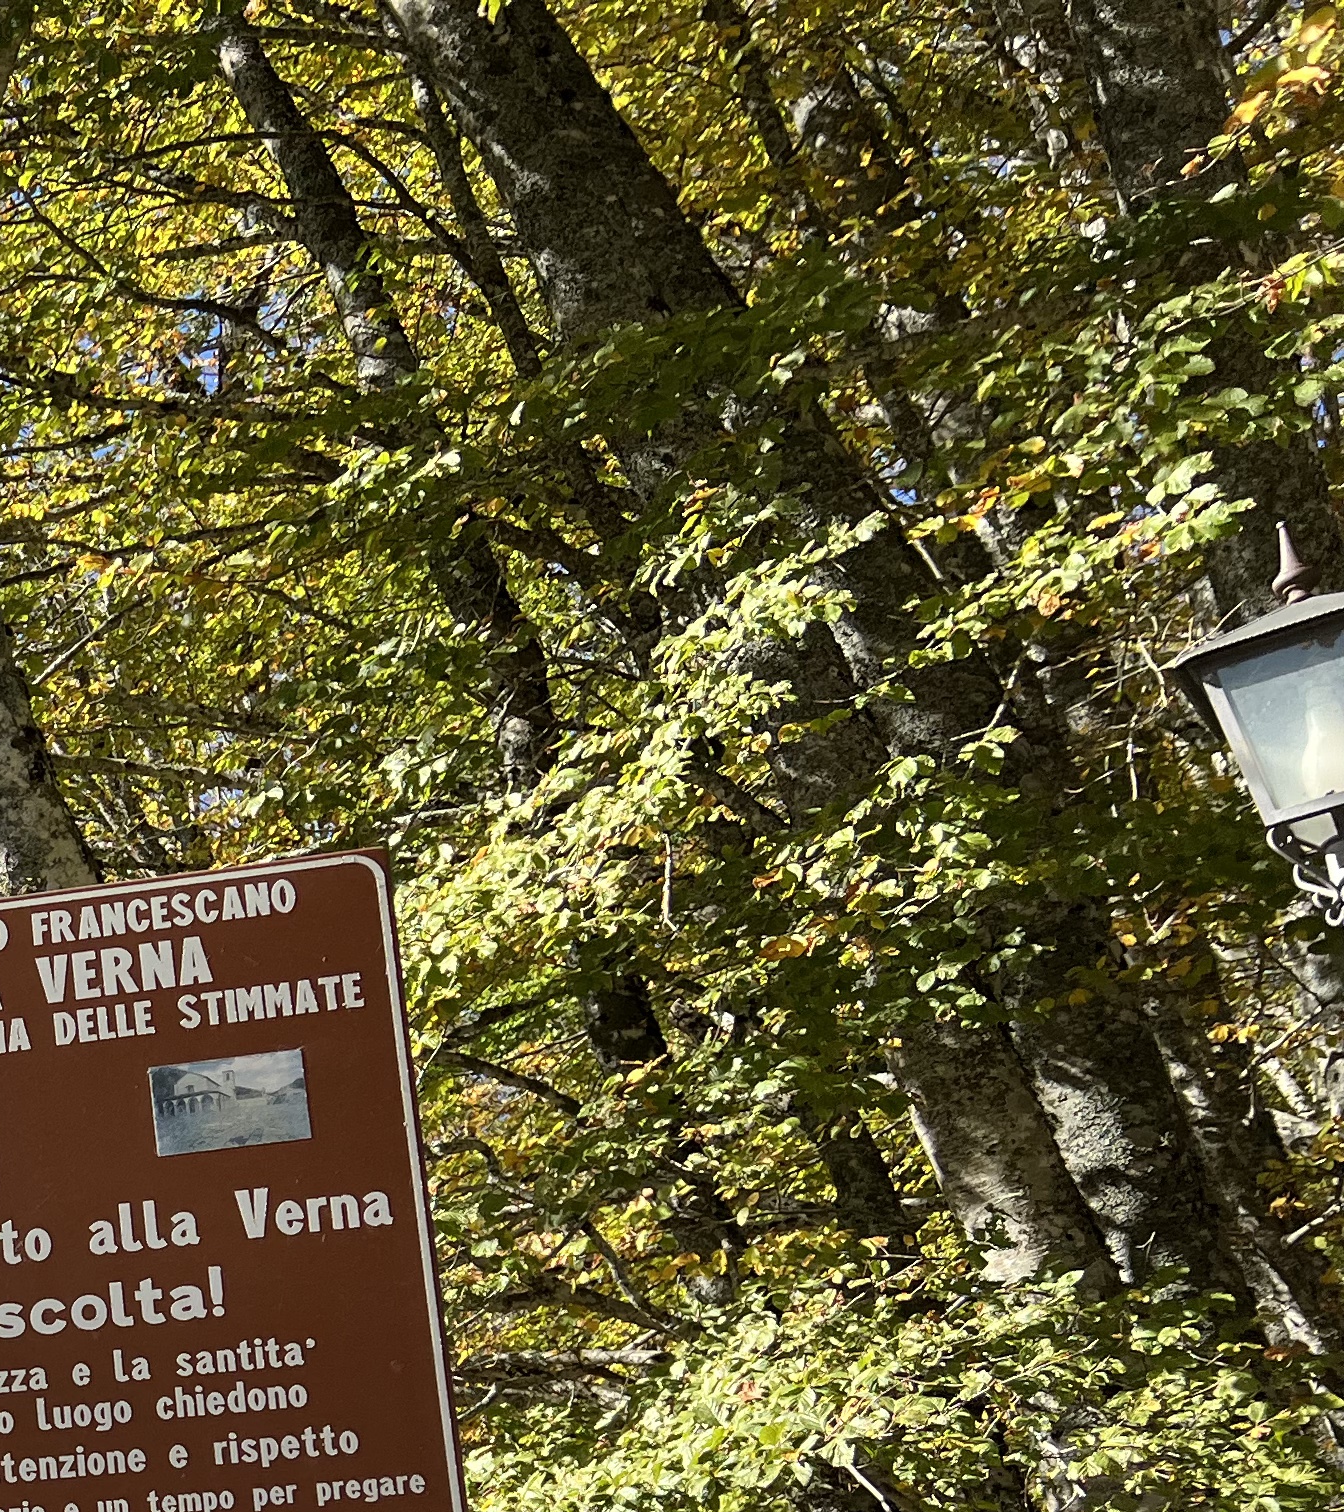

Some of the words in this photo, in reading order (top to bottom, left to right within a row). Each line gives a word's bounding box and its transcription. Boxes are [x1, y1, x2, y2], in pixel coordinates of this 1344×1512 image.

[30, 878, 297, 947] FRANCESCANO
[34, 935, 214, 1004] VERNA
[52, 999, 156, 1047] DELLE
[177, 972, 365, 1029] STIMMATE
[88, 1199, 201, 1256] alla
[233, 1187, 394, 1239] Verna
[71, 1362, 91, 1387] e
[112, 1349, 152, 1383] la
[35, 1397, 132, 1432] luogo
[155, 1380, 308, 1420] chiedono
[168, 1444, 189, 1469] e
[213, 1424, 359, 1468] rispetto
[252, 1484, 297, 1512] per
[315, 1474, 426, 1507] pregare
